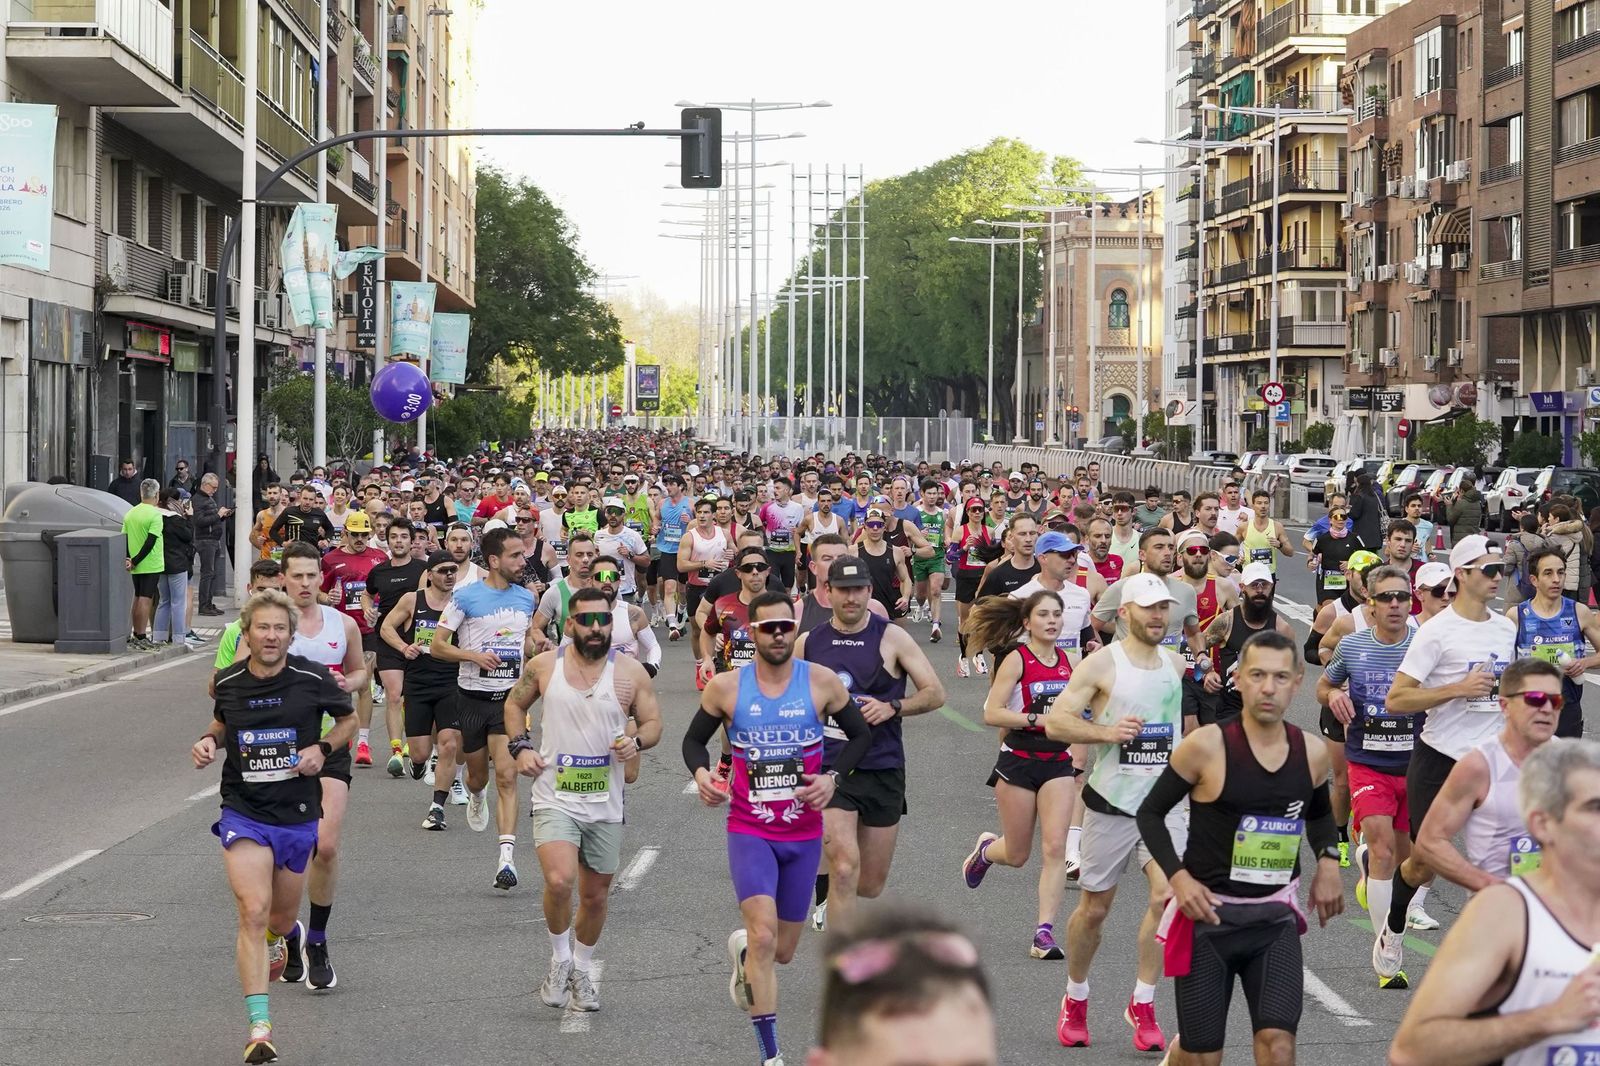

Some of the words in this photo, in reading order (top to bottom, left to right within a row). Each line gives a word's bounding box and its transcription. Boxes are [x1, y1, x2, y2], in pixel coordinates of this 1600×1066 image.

[404, 393, 422, 412] 3:00
[1382, 400, 1397, 412] 5€
[778, 709, 806, 718] apyou
[1142, 726, 1170, 734] ZURICH
[257, 732, 290, 741] ZURICH
[736, 728, 816, 744] CREDUS
[260, 748, 277, 756] 4133
[1127, 752, 1168, 763] TOMASZ
[249, 756, 290, 770] CARLOS
[766, 765, 784, 773] 3707
[561, 780, 605, 792] ALBERTO
[754, 774, 797, 788] LUENGO
[1261, 821, 1296, 832] ZURICH
[1261, 841, 1280, 850] 2298
[1234, 856, 1258, 868] LUIS
[1260, 858, 1294, 868] ENRIQUE
